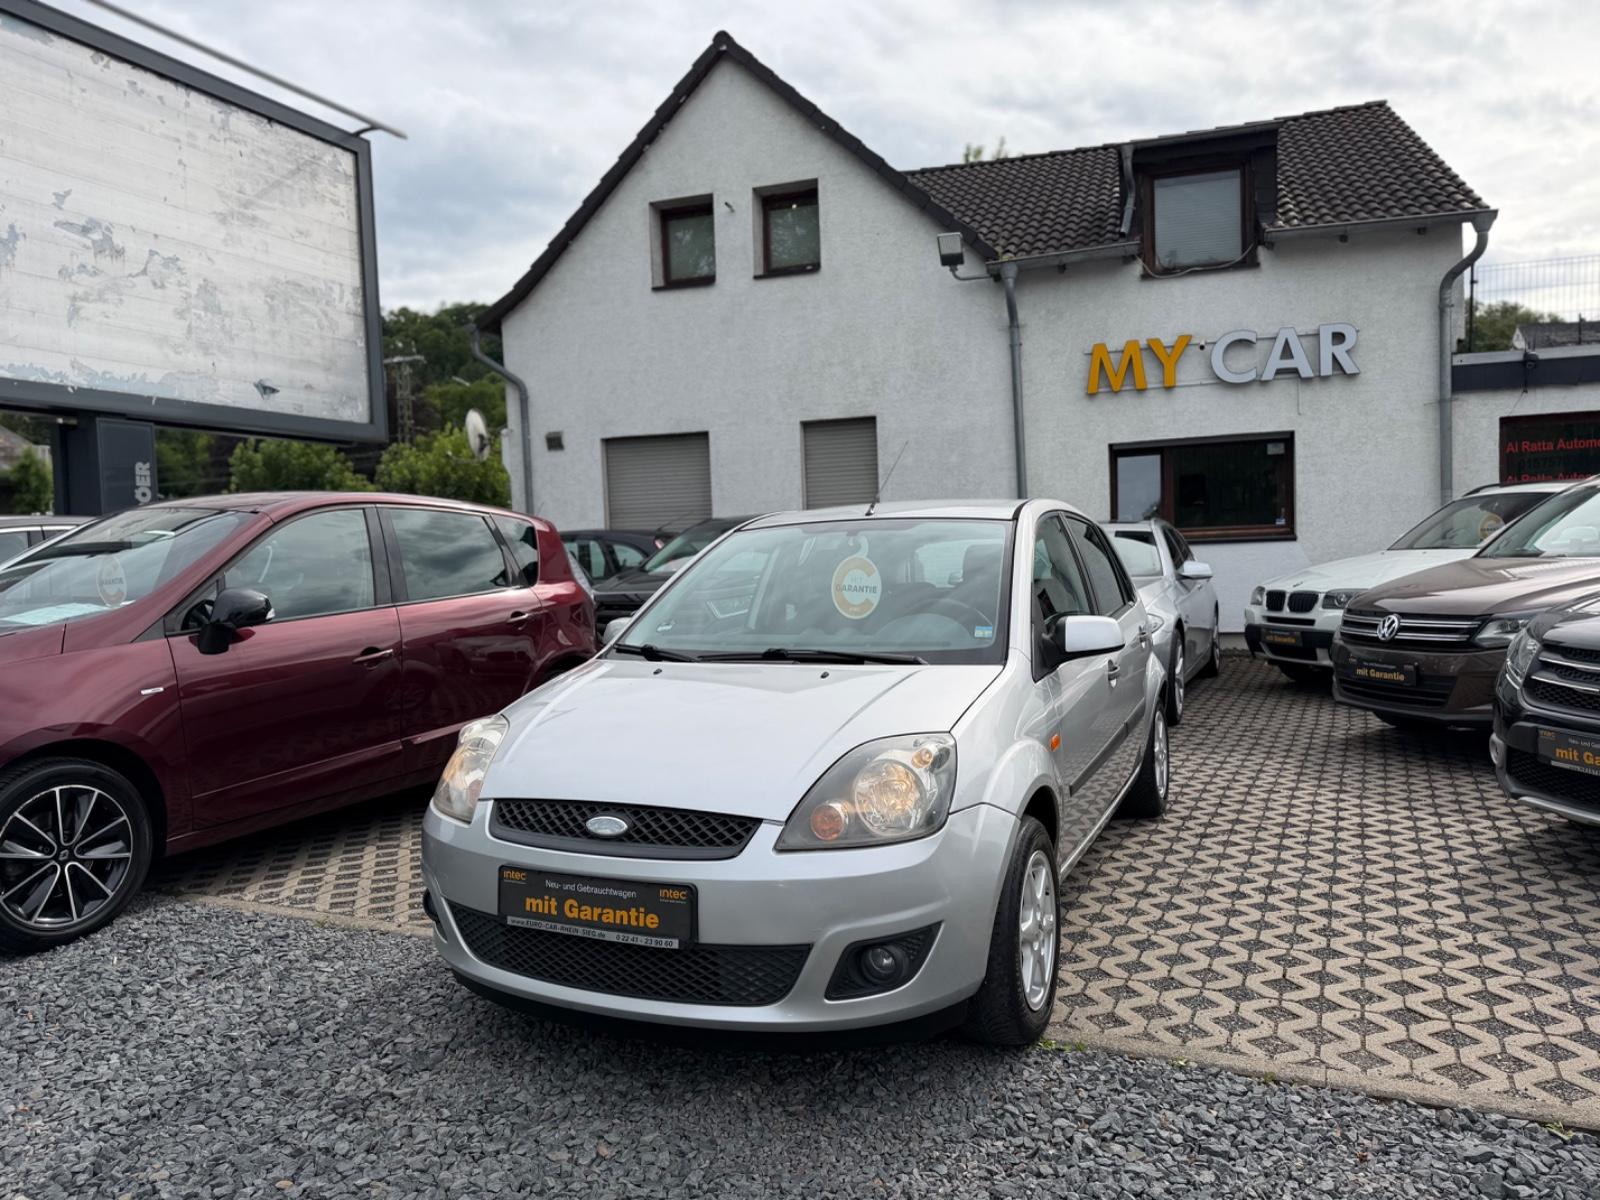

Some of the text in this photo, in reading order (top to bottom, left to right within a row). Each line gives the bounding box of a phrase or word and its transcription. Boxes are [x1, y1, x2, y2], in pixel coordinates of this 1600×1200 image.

[1086, 321, 1361, 395] MY CAR
[1521, 440, 1553, 452] Ratta
[134, 461, 152, 503] ÖER
[835, 584, 878, 594] GARANTIE
[1369, 668, 1405, 681] Garantie
[1555, 747, 1580, 761] mit
[503, 870, 527, 881] intec
[545, 880, 637, 899] Neu- und Gebrauchtwagen
[659, 888, 688, 900] intec
[525, 895, 660, 929] mit Garantie
